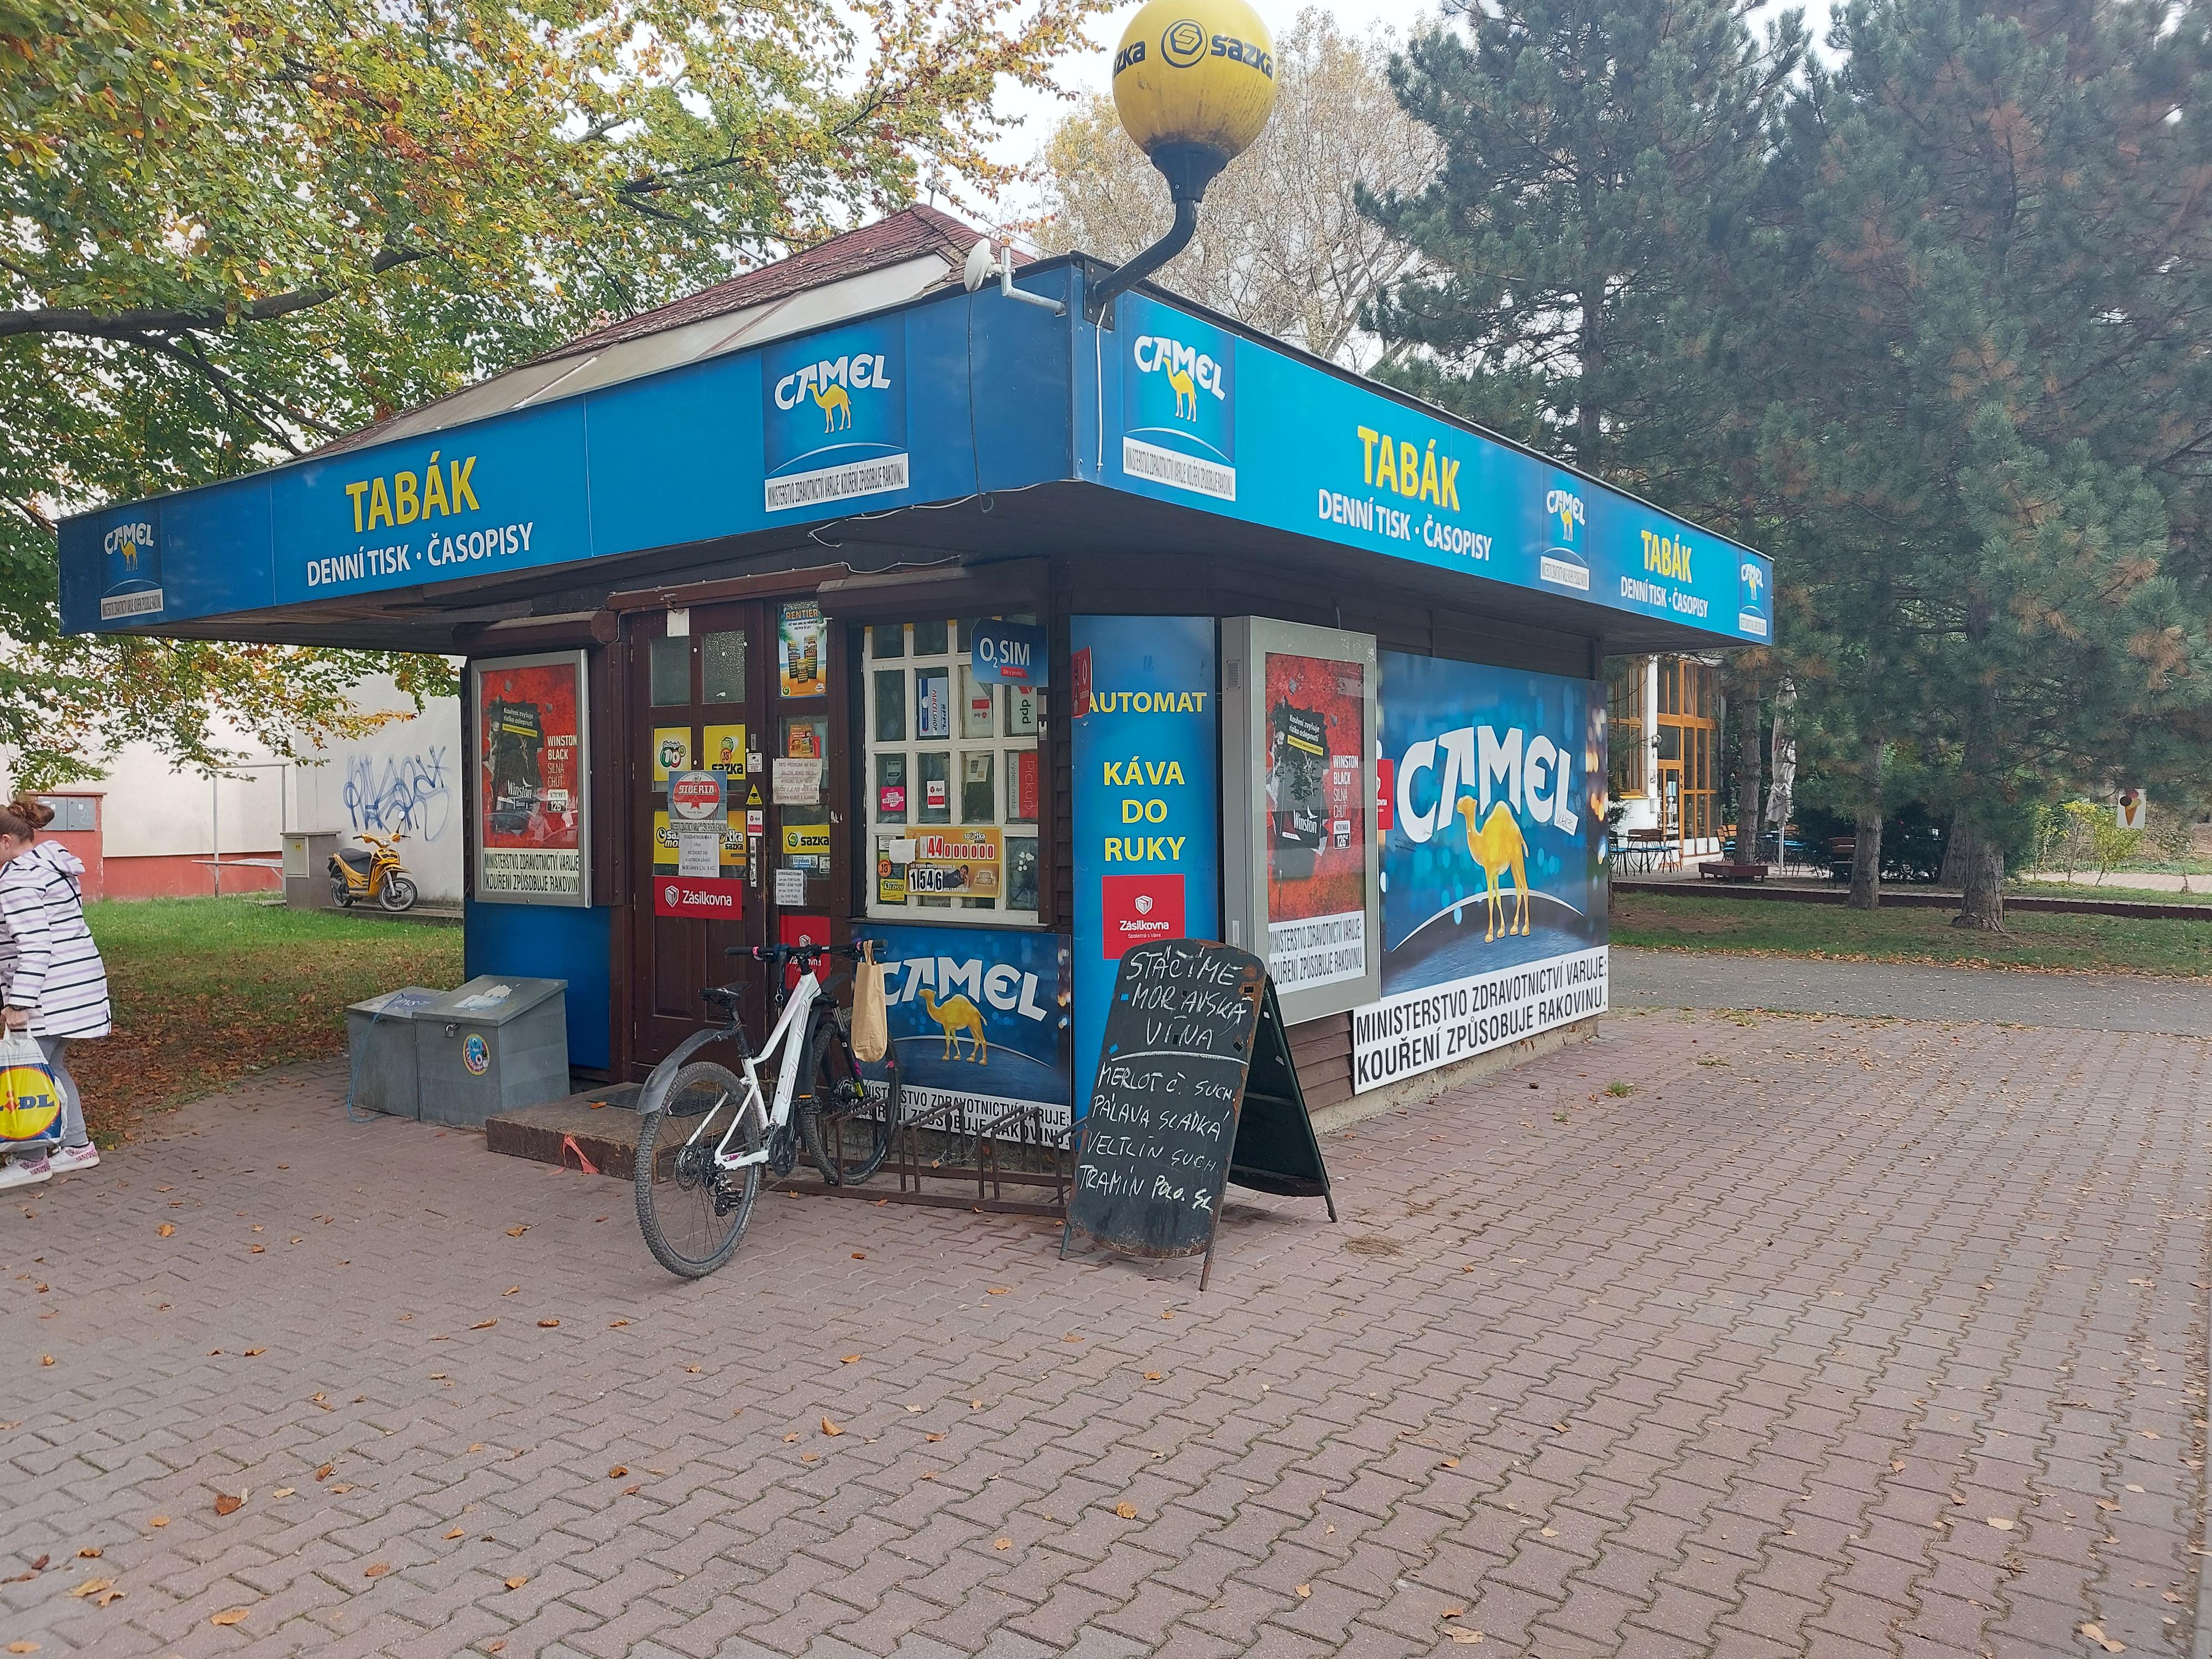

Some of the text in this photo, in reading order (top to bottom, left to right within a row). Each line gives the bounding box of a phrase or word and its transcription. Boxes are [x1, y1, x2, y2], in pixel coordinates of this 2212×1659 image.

[1134, 335, 1227, 401] CAMEL
[774, 353, 891, 410] CAMEL
[1357, 425, 1460, 512] TABÁK
[345, 451, 480, 534] TABÁK
[767, 481, 795, 508] MINISTERSTVO
[795, 471, 825, 503] ZDRAVOTNICTVÍ
[841, 465, 859, 495] KOUŘENÍ
[1547, 489, 1587, 526] CAMEL
[1318, 488, 1493, 561] DENNÍ TISK ČASOPISY
[104, 523, 154, 555] CAMEL
[307, 521, 534, 587] DENNÍ TISK ČASOPISY
[1641, 529, 1693, 583] TABÁK
[1741, 563, 1764, 589] CAMEL
[1620, 575, 1708, 618] DENNÍ TISK ČASOPISY
[786, 608, 818, 620] RENTIER
[999, 639, 1030, 666] SIM
[1020, 699, 1031, 724] dpd
[1089, 691, 1208, 713] AUTOMAT
[547, 734, 577, 747] WINSTON
[547, 760, 565, 775] SILNÁ
[548, 749, 568, 760] BLACK
[1333, 754, 1359, 769] WINSTON
[547, 774, 564, 788] CHUŤ
[1104, 755, 1186, 786] KÁVA
[1333, 771, 1351, 785] BLACK
[507, 779, 532, 800] Winston
[679, 784, 716, 795] SIBERIA
[1023, 760, 1035, 810] Pickup
[1333, 785, 1348, 802] SILNÁ
[1397, 725, 1580, 844] CAMEL
[1121, 799, 1168, 824] DO
[1293, 809, 1317, 834] Winston
[1333, 802, 1348, 818] CHUŤ
[800, 836, 829, 846] sazka
[1104, 837, 1186, 862] RUKY
[484, 851, 579, 872] MINISTERSTVO ZDRAVOTNICTVÍ VARUJE
[485, 871, 579, 893] KOUŘENÍ ZPŮSOBUJE RAKOVIN
[910, 870, 942, 891] 1546
[682, 890, 732, 906] Zásilkovna
[1119, 920, 1170, 931] Zásilkovna
[1269, 916, 1361, 954] MINISTERSTVO ZDRAVOTNICTVÍ VARUJE:
[1269, 946, 1362, 985] KOUŘENÍ ZPŮSOBUJE RAKOVINU
[883, 957, 1047, 1021] CAMEL
[1356, 955, 1607, 1046] MINISTERSTVO ZDRAVOTNICTVÍ VARUJE:
[1357, 986, 1607, 1087] KOUŘENÍ ZPŮSOBUJE RAKOVINU.
[1097, 1061, 1165, 1093] MERLOT
[1092, 1092, 1150, 1127] PÁLAVA
[1079, 1163, 1144, 1198] TRAMÍN
